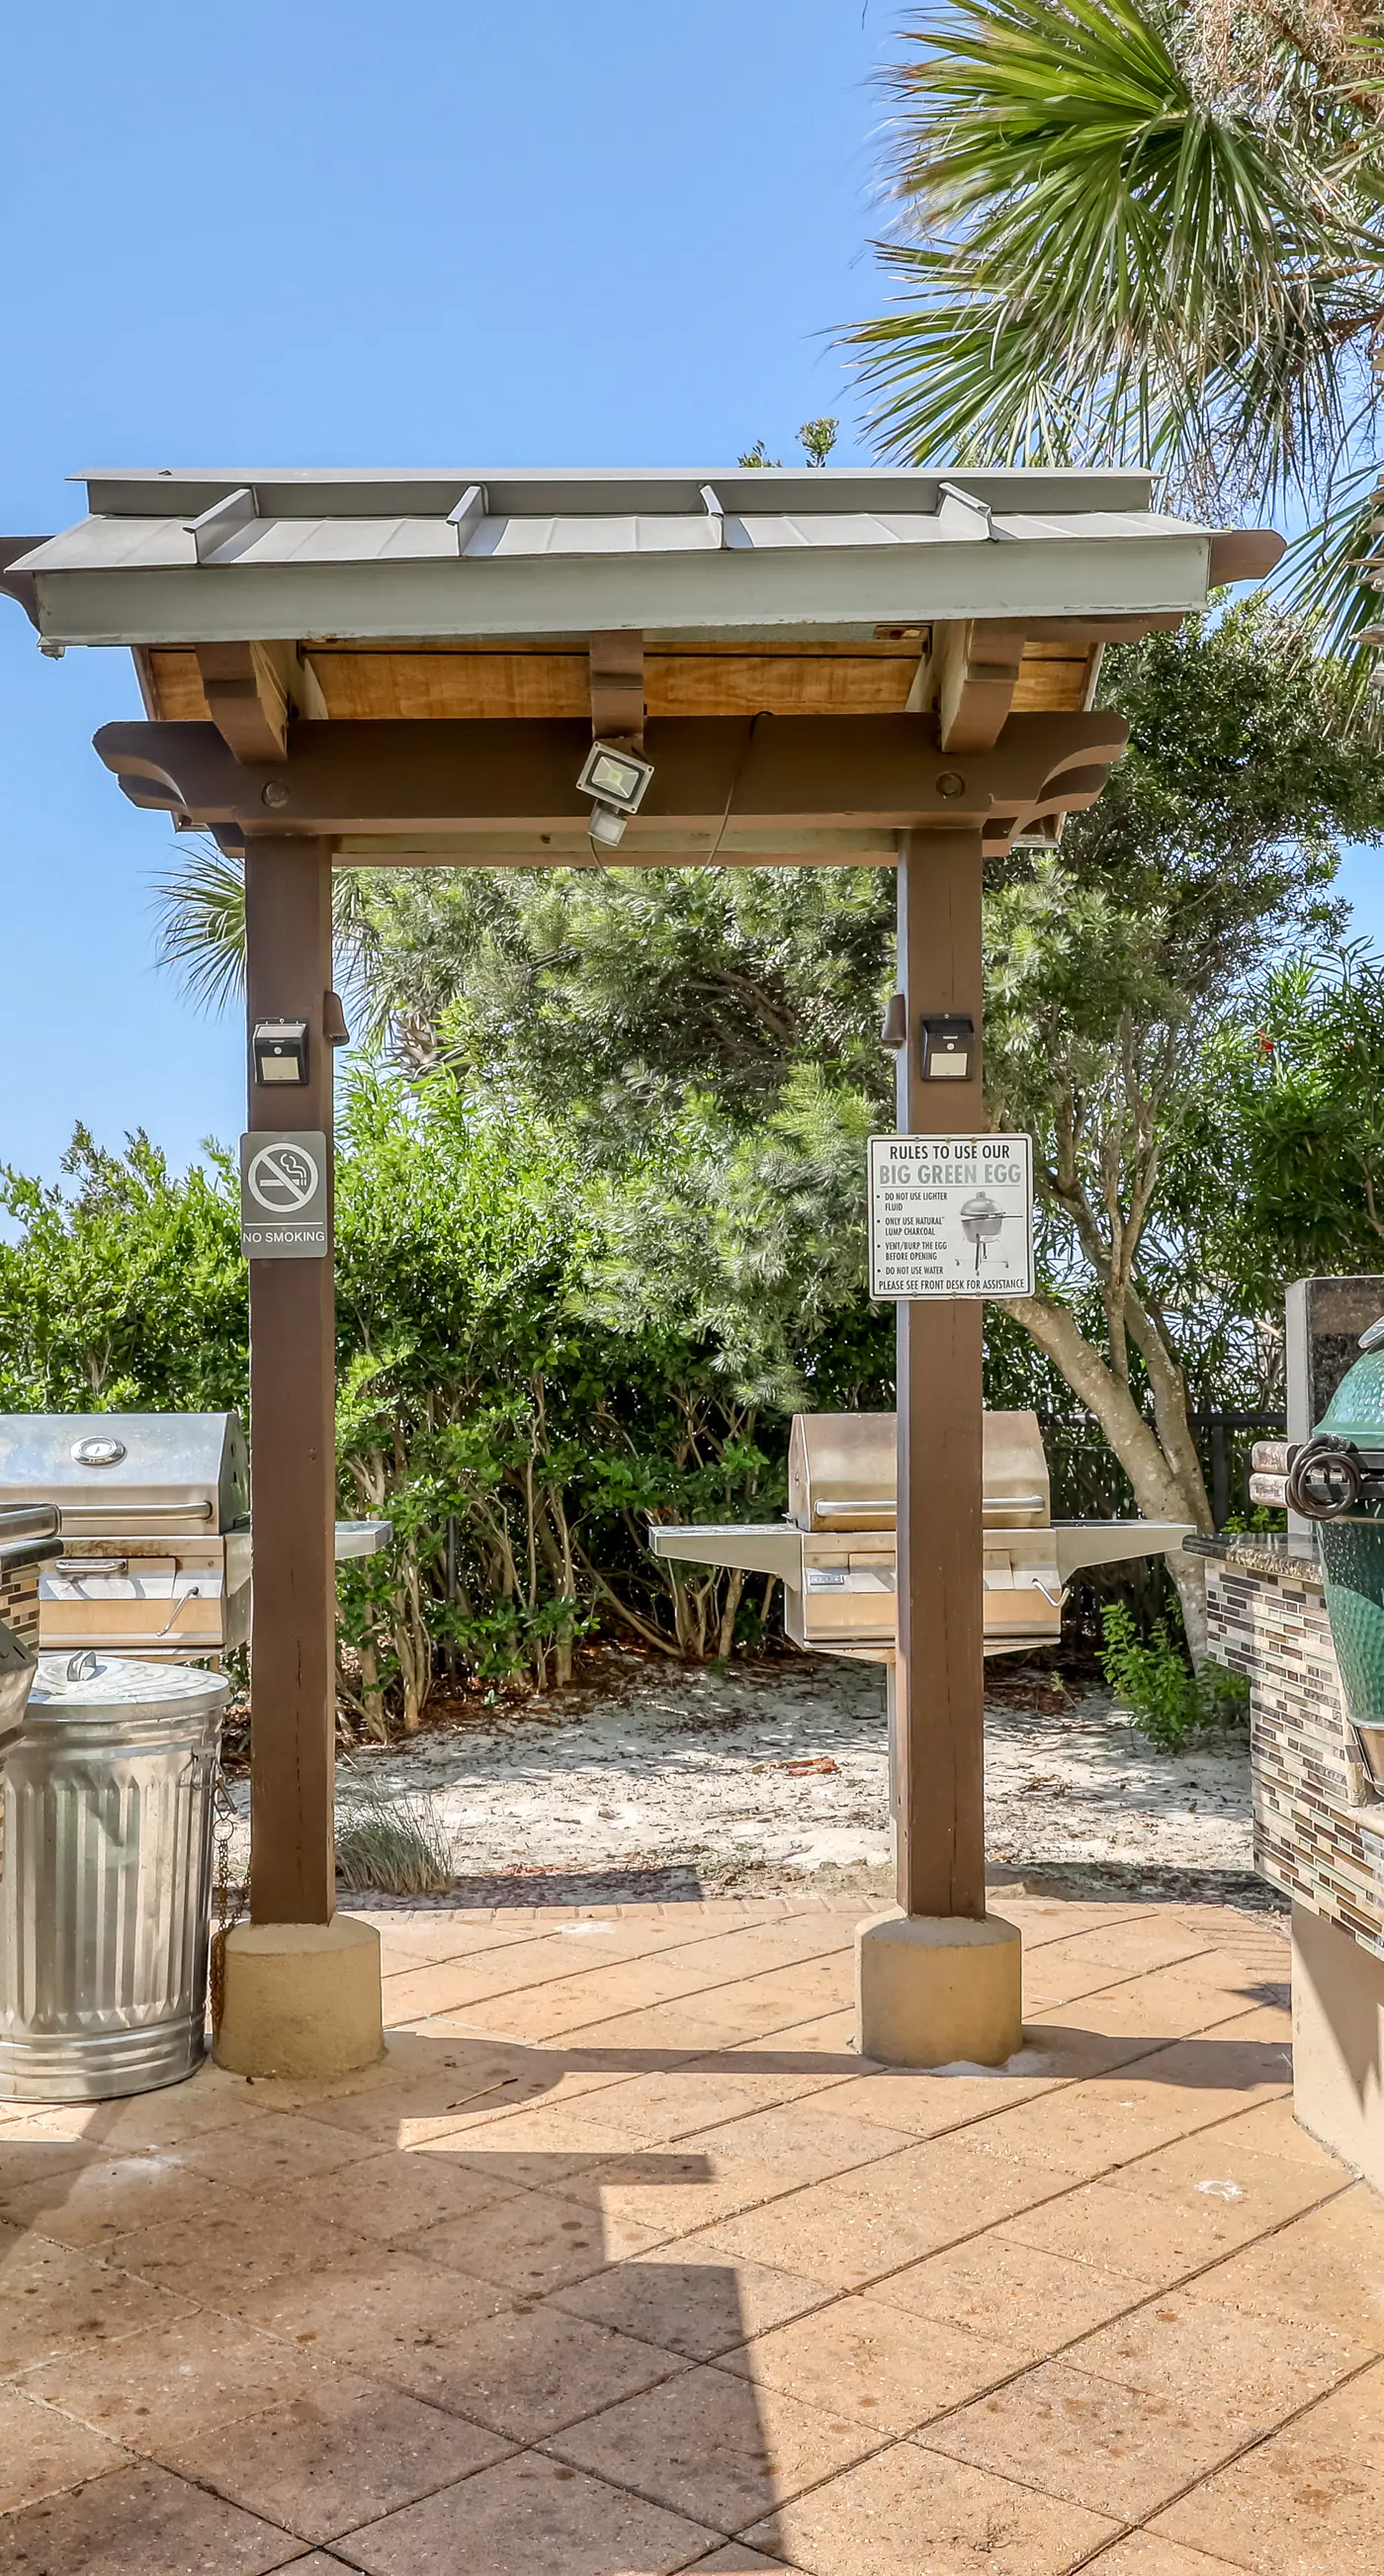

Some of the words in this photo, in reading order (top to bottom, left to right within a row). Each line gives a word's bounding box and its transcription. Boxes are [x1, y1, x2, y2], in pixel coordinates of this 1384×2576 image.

[890, 1146, 928, 1159] RULES
[933, 1146, 949, 1159] TO
[955, 1145, 977, 1159] USE
[982, 1145, 1010, 1159] OUR
[880, 1165, 910, 1185] BIG
[917, 1164, 977, 1184] GREEN
[985, 1164, 1021, 1184] EGG
[922, 1192, 947, 1200] LIGHTER
[885, 1202, 903, 1211] FLUID
[885, 1227, 903, 1236] LUMP
[242, 1232, 262, 1243] NO
[265, 1231, 325, 1242] SMOKING
[886, 1252, 908, 1261] BEFORE
[879, 1281, 905, 1290] PLEASE
[906, 1281, 918, 1289] SEE
[920, 1280, 944, 1289] FRONT
[946, 1280, 965, 1289] DESK
[967, 1280, 981, 1289] FOR
[983, 1279, 1025, 1289] ASSISTANCE
